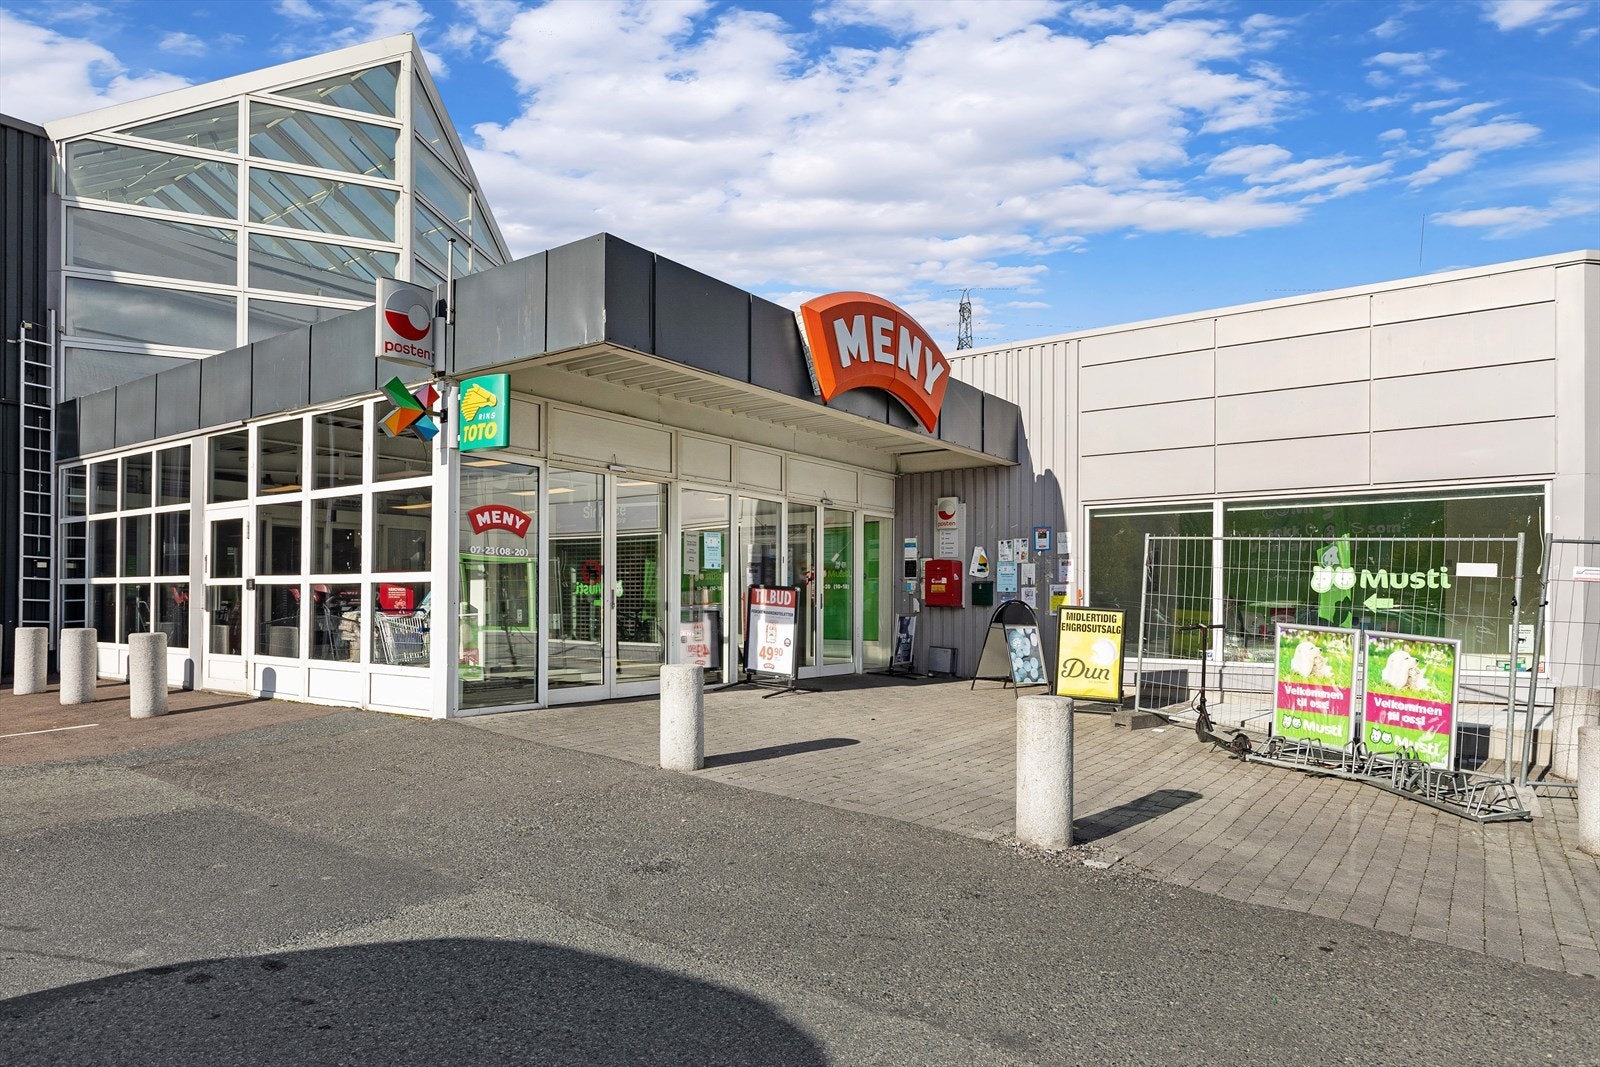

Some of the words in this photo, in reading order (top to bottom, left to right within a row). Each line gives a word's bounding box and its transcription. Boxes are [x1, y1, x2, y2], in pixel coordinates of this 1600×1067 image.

[384, 340, 431, 360] posten
[832, 314, 945, 396] MENY
[478, 412, 496, 420] RIKS
[463, 421, 497, 443] TOTO
[475, 510, 526, 530] MENY
[1359, 566, 1452, 590] Musti
[1066, 612, 1117, 623] MIDLERTIDIG
[1061, 623, 1122, 634] ENGROSUTSALG
[1061, 657, 1110, 681] Dun
[1283, 684, 1344, 700] Velkommen
[1296, 698, 1308, 707] til
[1309, 700, 1330, 709] oss!
[1373, 697, 1443, 717] Velkommen
[1386, 711, 1400, 721] til
[1401, 714, 1426, 725] oss!
[1302, 719, 1343, 738] Musti
